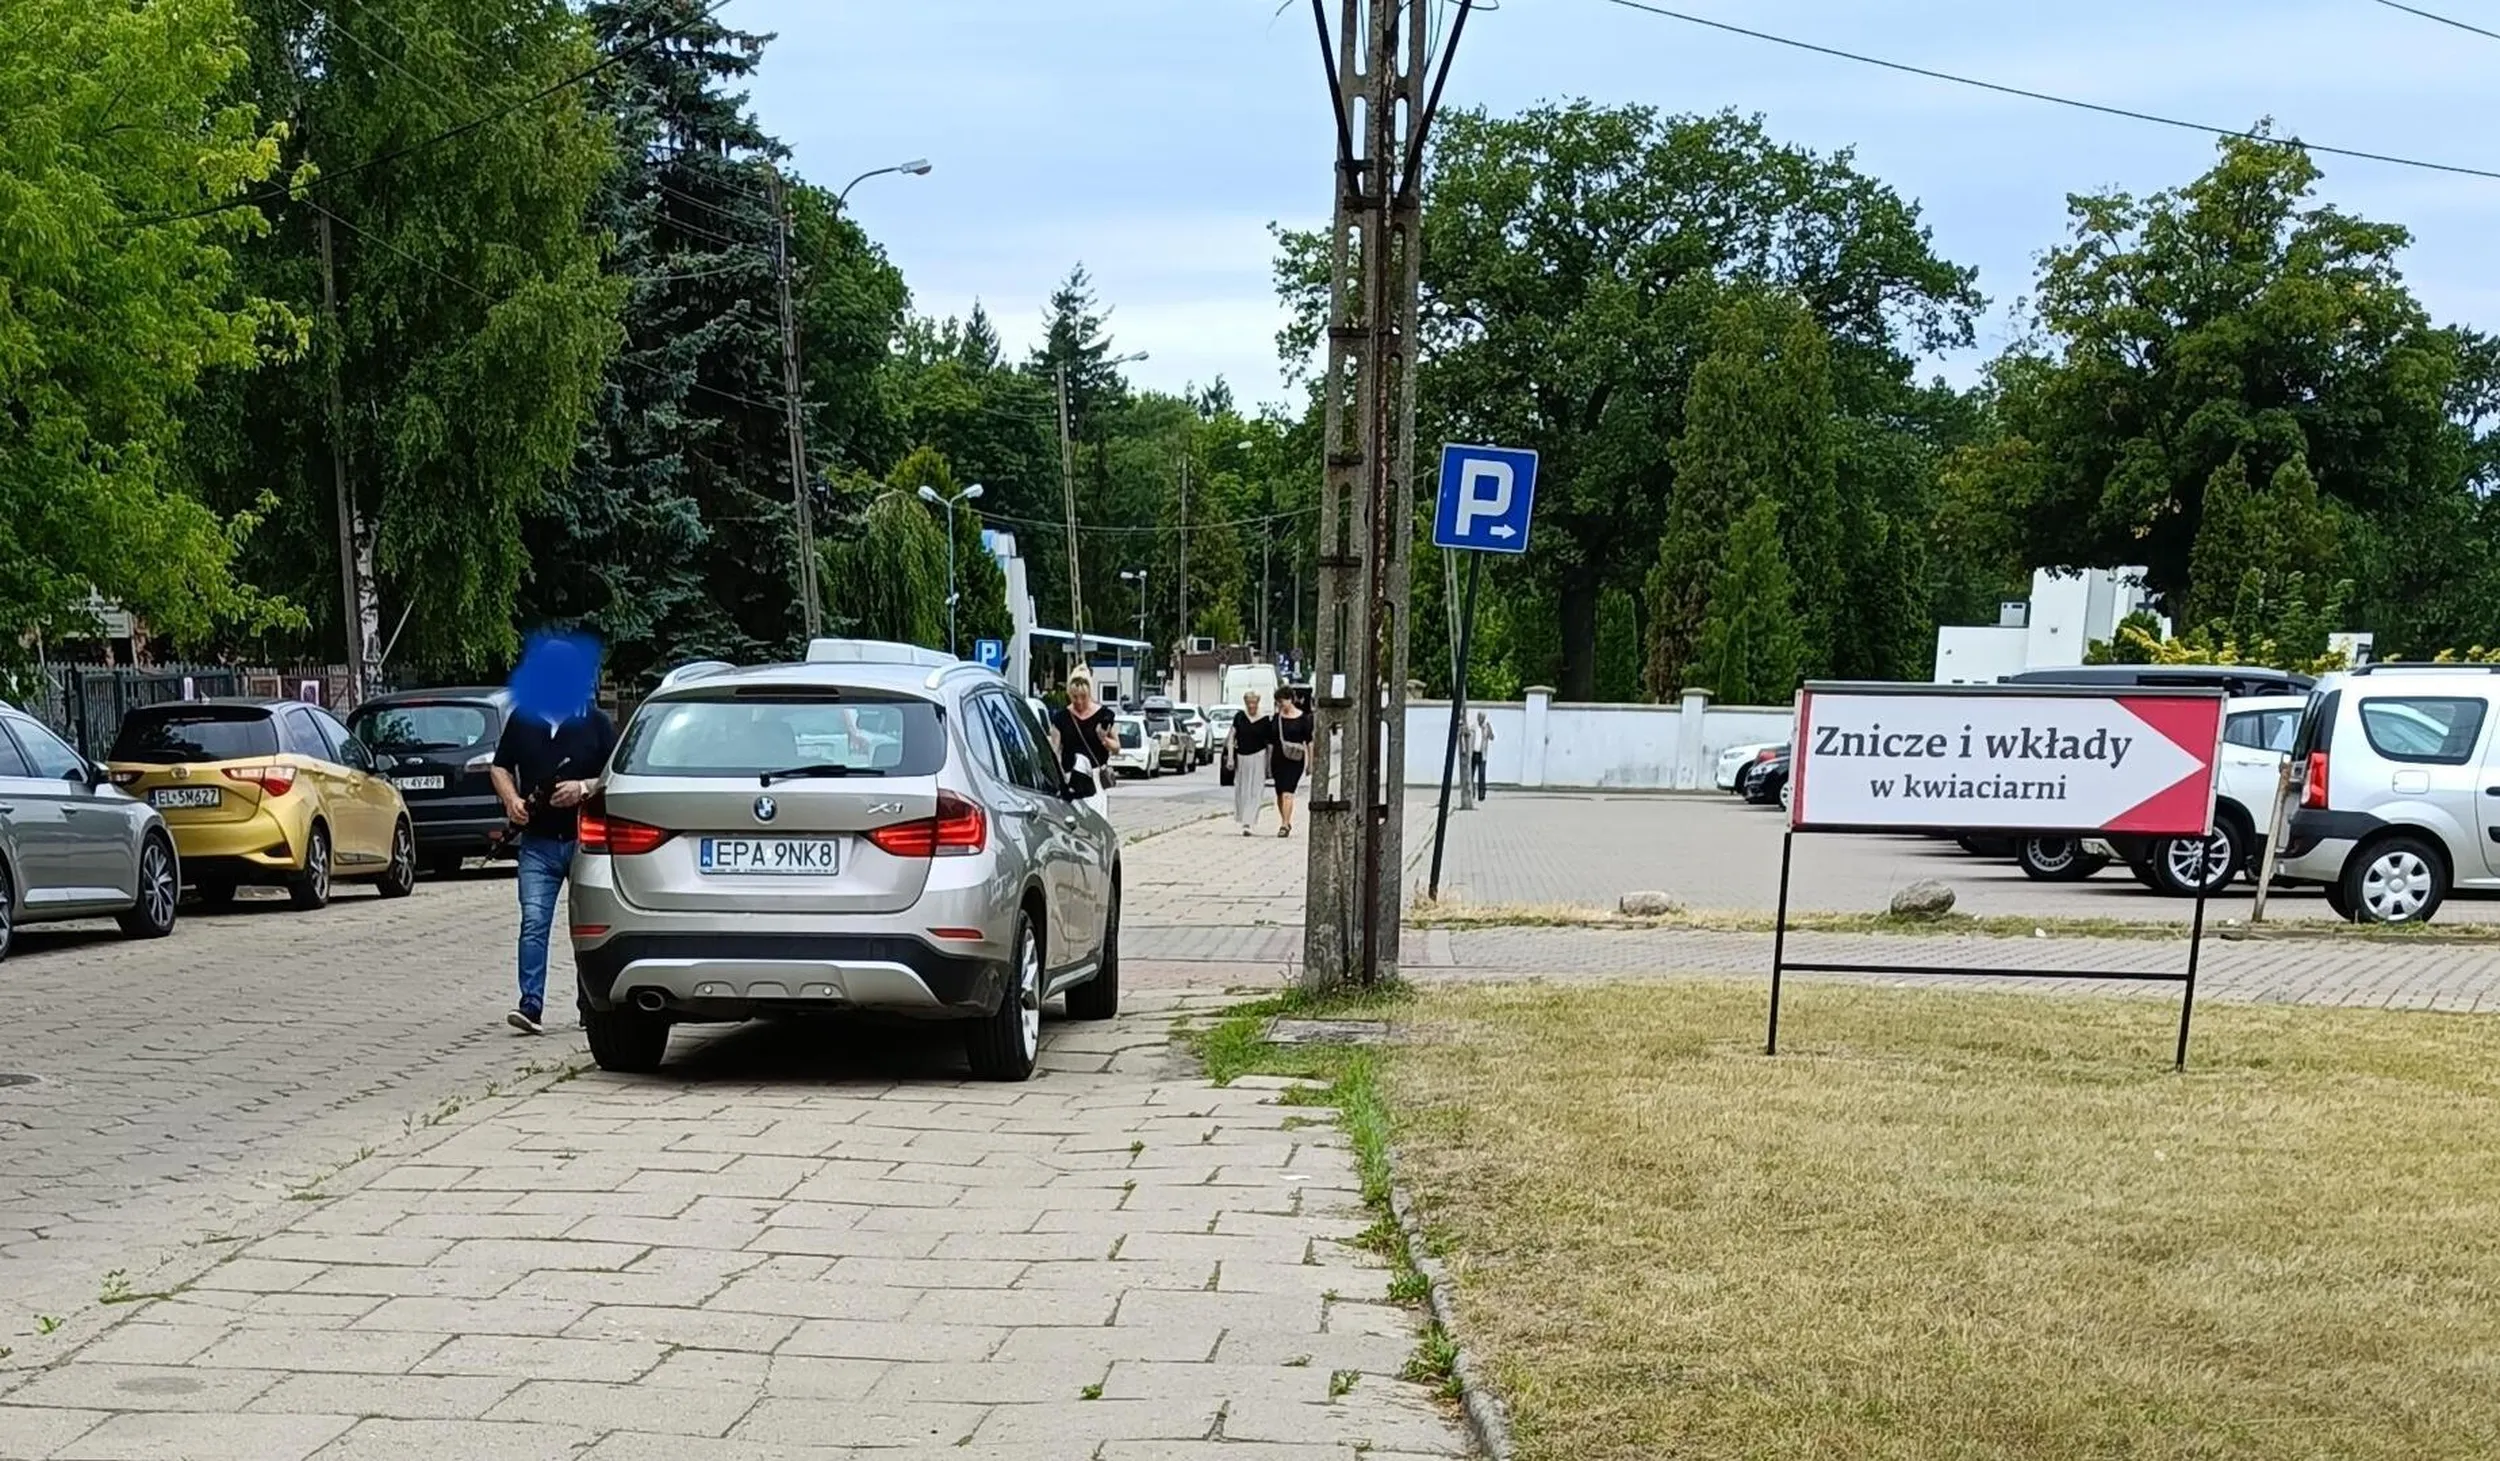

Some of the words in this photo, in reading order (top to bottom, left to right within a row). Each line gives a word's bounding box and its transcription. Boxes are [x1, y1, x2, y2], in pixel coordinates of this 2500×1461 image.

[1455, 458, 1514, 536] P
[981, 642, 997, 665] P
[1814, 723, 1948, 758] Znicze
[1958, 724, 1972, 758] i
[1985, 726, 2133, 769] wkłady
[158, 791, 174, 805] EL
[1870, 780, 1895, 798] w
[1903, 774, 2067, 800] kwiaciarni
[717, 842, 766, 867] EPA
[775, 842, 833, 867] 9NK8
